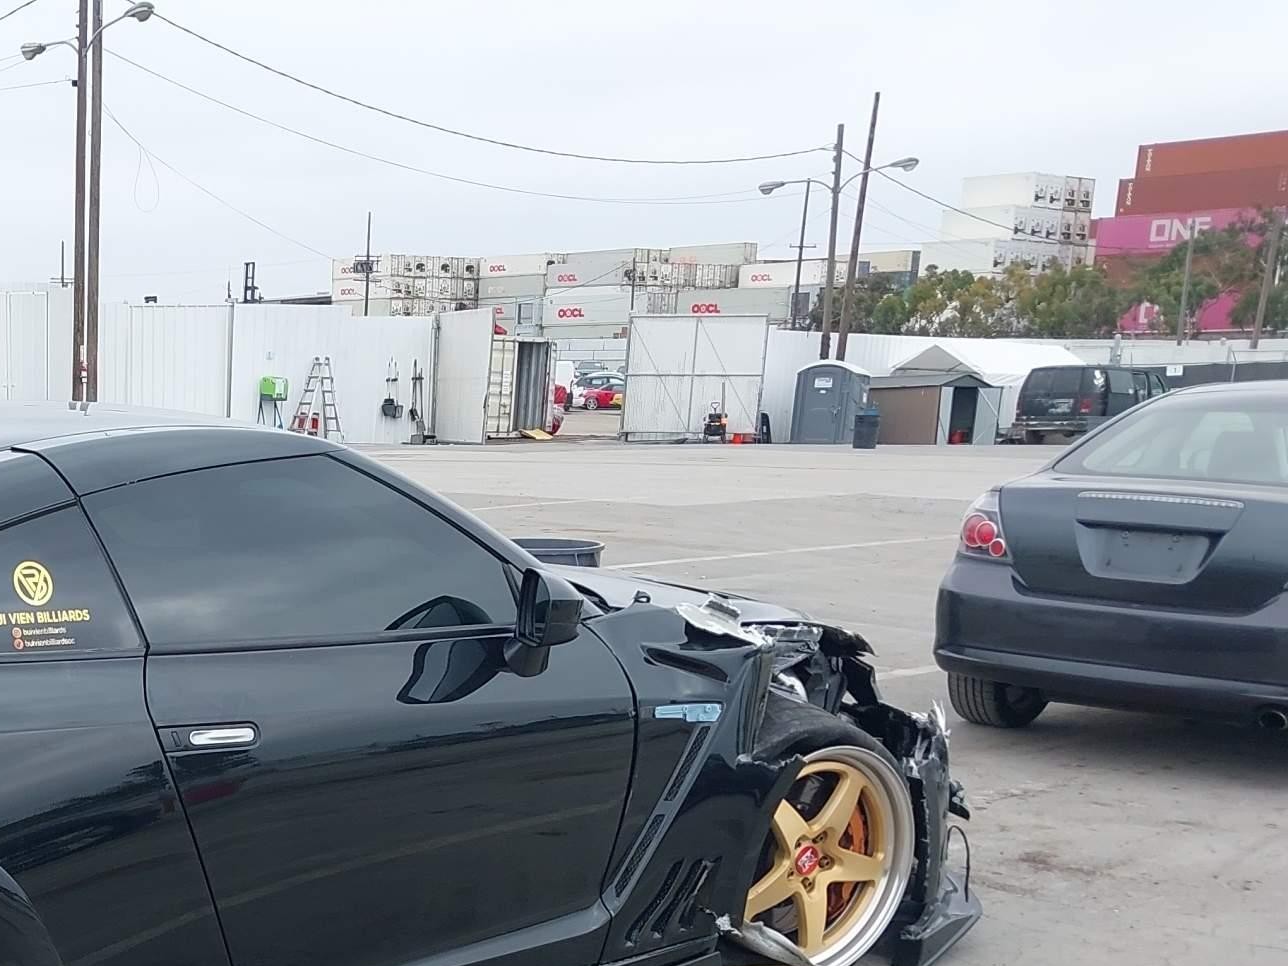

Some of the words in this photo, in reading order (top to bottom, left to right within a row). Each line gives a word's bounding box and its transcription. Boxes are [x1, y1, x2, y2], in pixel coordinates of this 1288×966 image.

[558, 274, 577, 282] OOCL
[751, 273, 772, 281] OOCL
[558, 308, 584, 318] OOCL
[691, 303, 720, 313] OOCL
[8, 612, 35, 625] VIEN
[36, 609, 90, 624] BILLIARDS
